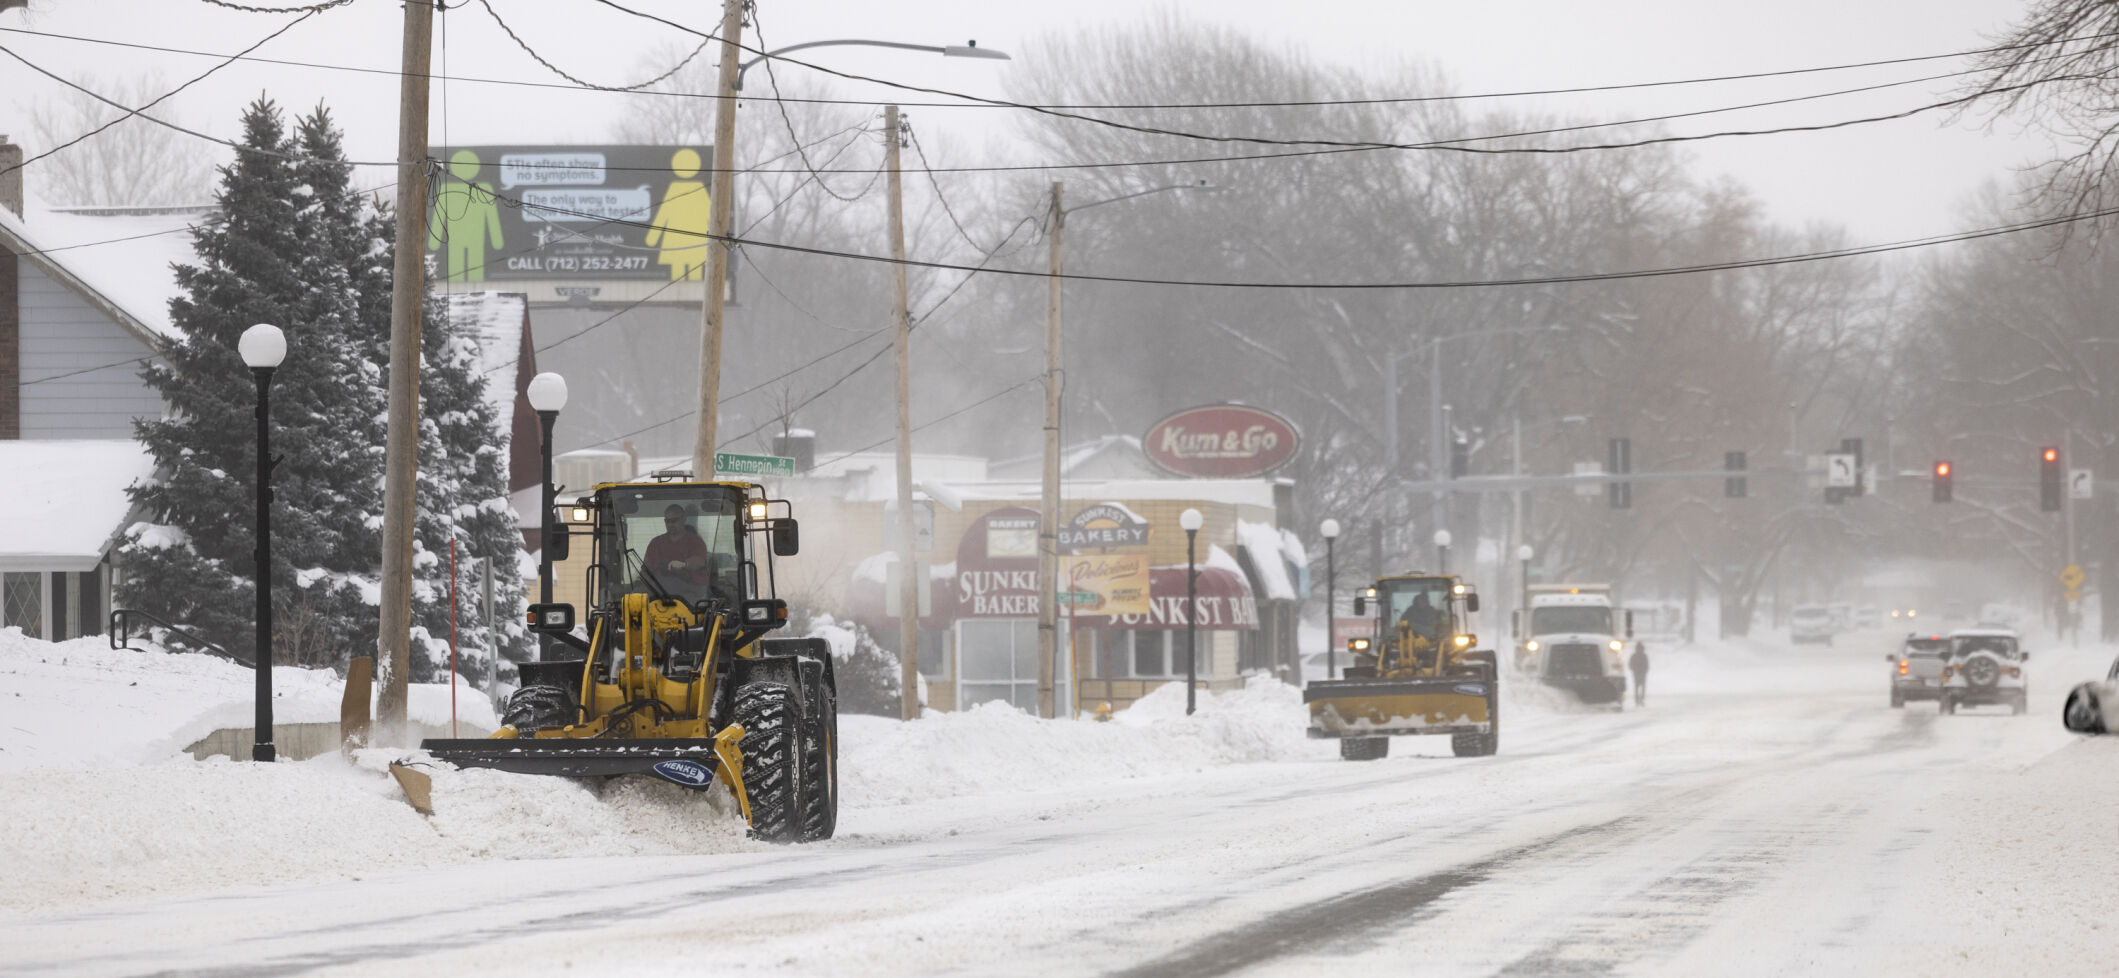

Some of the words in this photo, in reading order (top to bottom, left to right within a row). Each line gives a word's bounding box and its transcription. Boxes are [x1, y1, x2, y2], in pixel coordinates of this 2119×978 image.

[534, 159, 566, 169] often
[568, 159, 600, 169] show
[517, 171, 532, 180] no
[534, 170, 600, 182] symptoms.
[526, 194, 547, 205] The
[549, 194, 575, 207] only
[577, 195, 604, 207] way
[605, 194, 617, 205] to
[507, 257, 542, 270] CALL
[545, 257, 579, 272] (712)
[582, 257, 648, 270] 252-2477
[1161, 427, 1220, 454] Kum
[1223, 430, 1240, 451] &
[1242, 425, 1277, 454] Go
[717, 455, 724, 470] S
[728, 456, 773, 474] Hennepin
[779, 458, 786, 467] St
[988, 520, 1037, 528] BAKERY
[1075, 507, 1127, 526] SUNKIST
[1058, 528, 1144, 544] BAKERY
[960, 571, 1040, 603] SUNKI
[973, 595, 1040, 614] BAKER
[663, 762, 697, 776] HENKE
